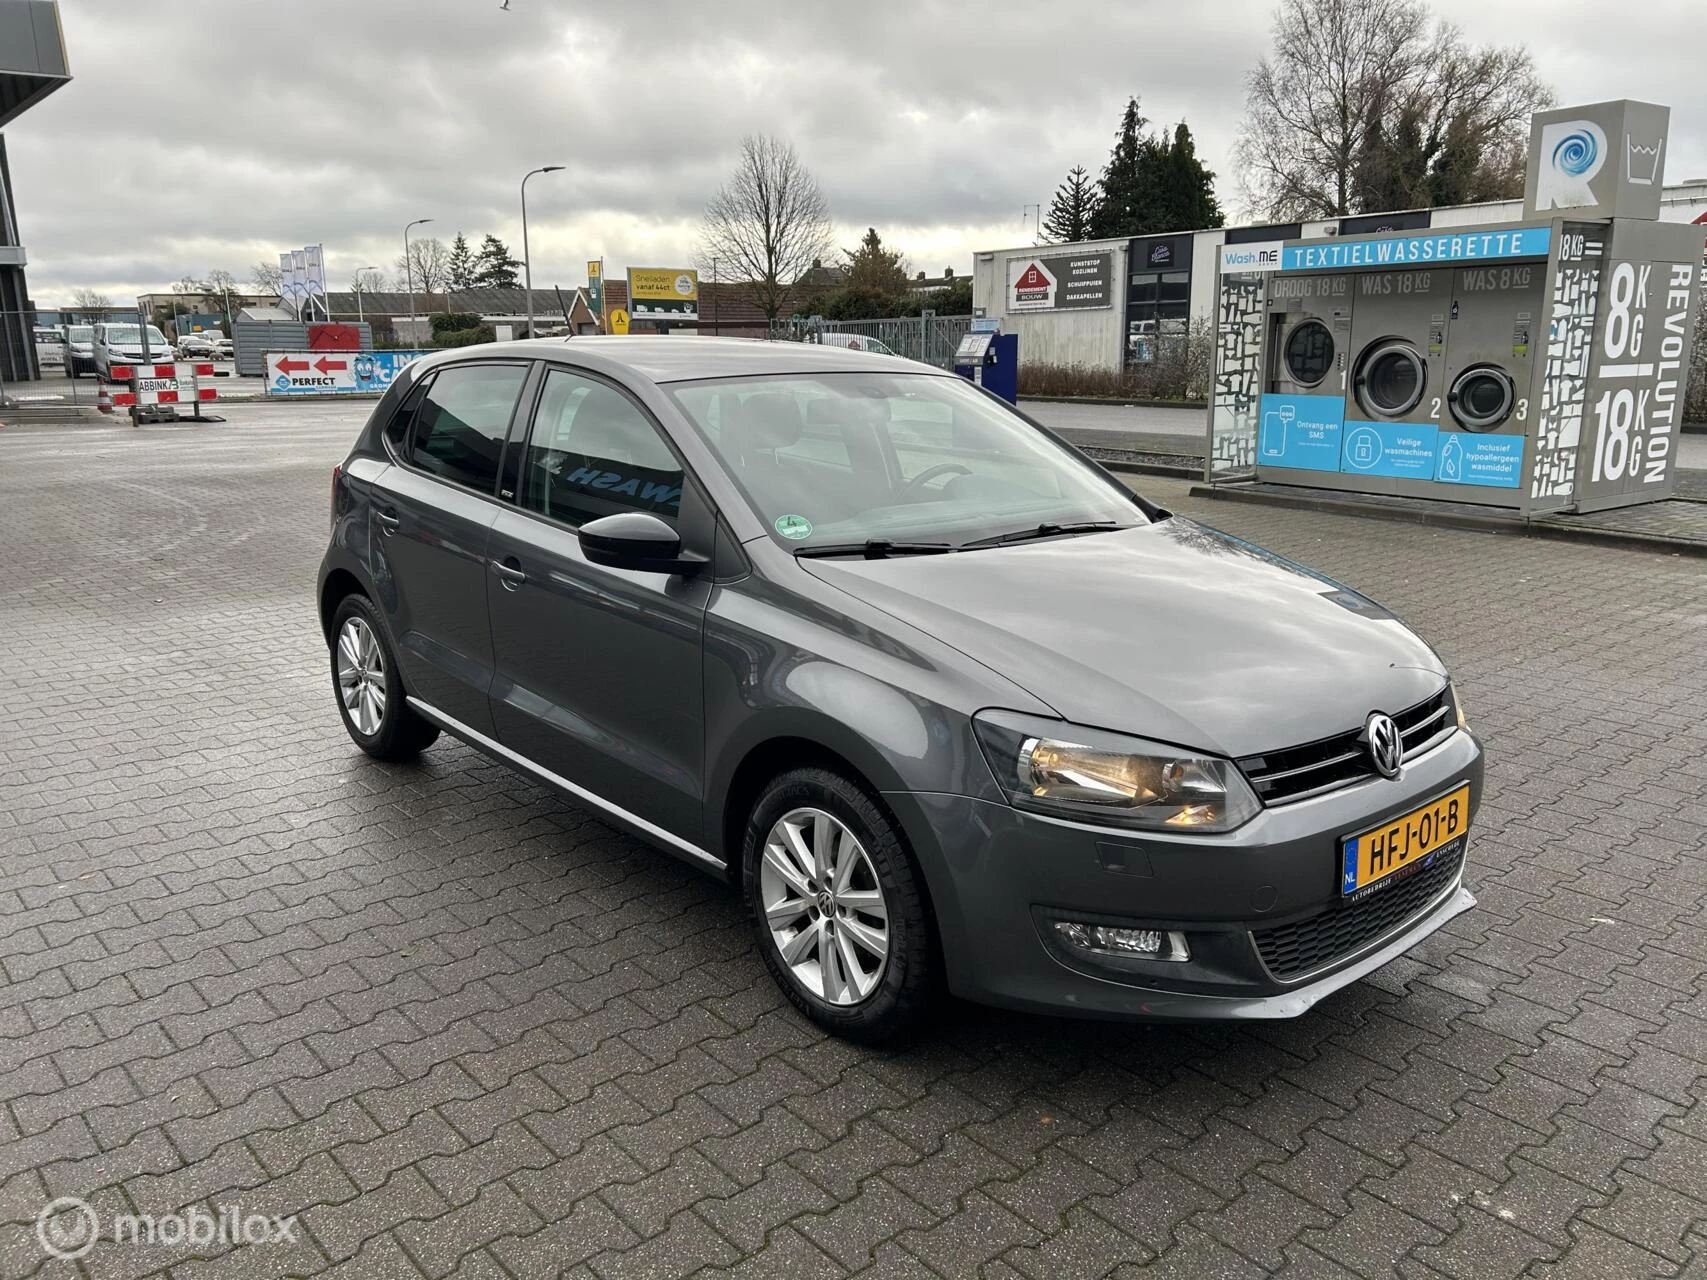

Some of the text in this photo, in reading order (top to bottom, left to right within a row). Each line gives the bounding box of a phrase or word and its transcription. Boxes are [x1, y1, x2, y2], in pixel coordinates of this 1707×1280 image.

[1295, 233, 1523, 267] TEXTIELWASSERETTE
[1070, 259, 1101, 268] KUNSTSTOF
[1072, 267, 1098, 275] KOZIJNEN
[1067, 279, 1103, 288] SCHUIFPUIEN
[1362, 274, 1392, 295] WAS
[1397, 273, 1412, 293] 18
[1463, 269, 1498, 290] WAS
[1500, 268, 1511, 289] 8
[636, 283, 655, 291] vanaf
[1274, 279, 1312, 297] DROOG
[1316, 278, 1330, 296] 18
[1066, 292, 1103, 300] DAKKAPELLEN
[1643, 264, 1693, 484] REVOLUTION
[292, 377, 336, 386] PERFECT
[1340, 370, 1347, 390] 1
[140, 380, 167, 391] ABBINK
[1431, 398, 1441, 418] 2
[1516, 399, 1528, 420] 3
[1296, 421, 1324, 431] Ontvang
[1309, 431, 1325, 439] SMS
[1397, 437, 1421, 447] Veilige
[1384, 448, 1433, 457] wasmachines
[1477, 443, 1511, 452] Inclusief
[1466, 452, 1520, 463] hypoallergeen
[1471, 463, 1513, 473] wasmiddel
[1370, 798, 1459, 876] HFJ-01-B
[1344, 872, 1356, 885] NL
